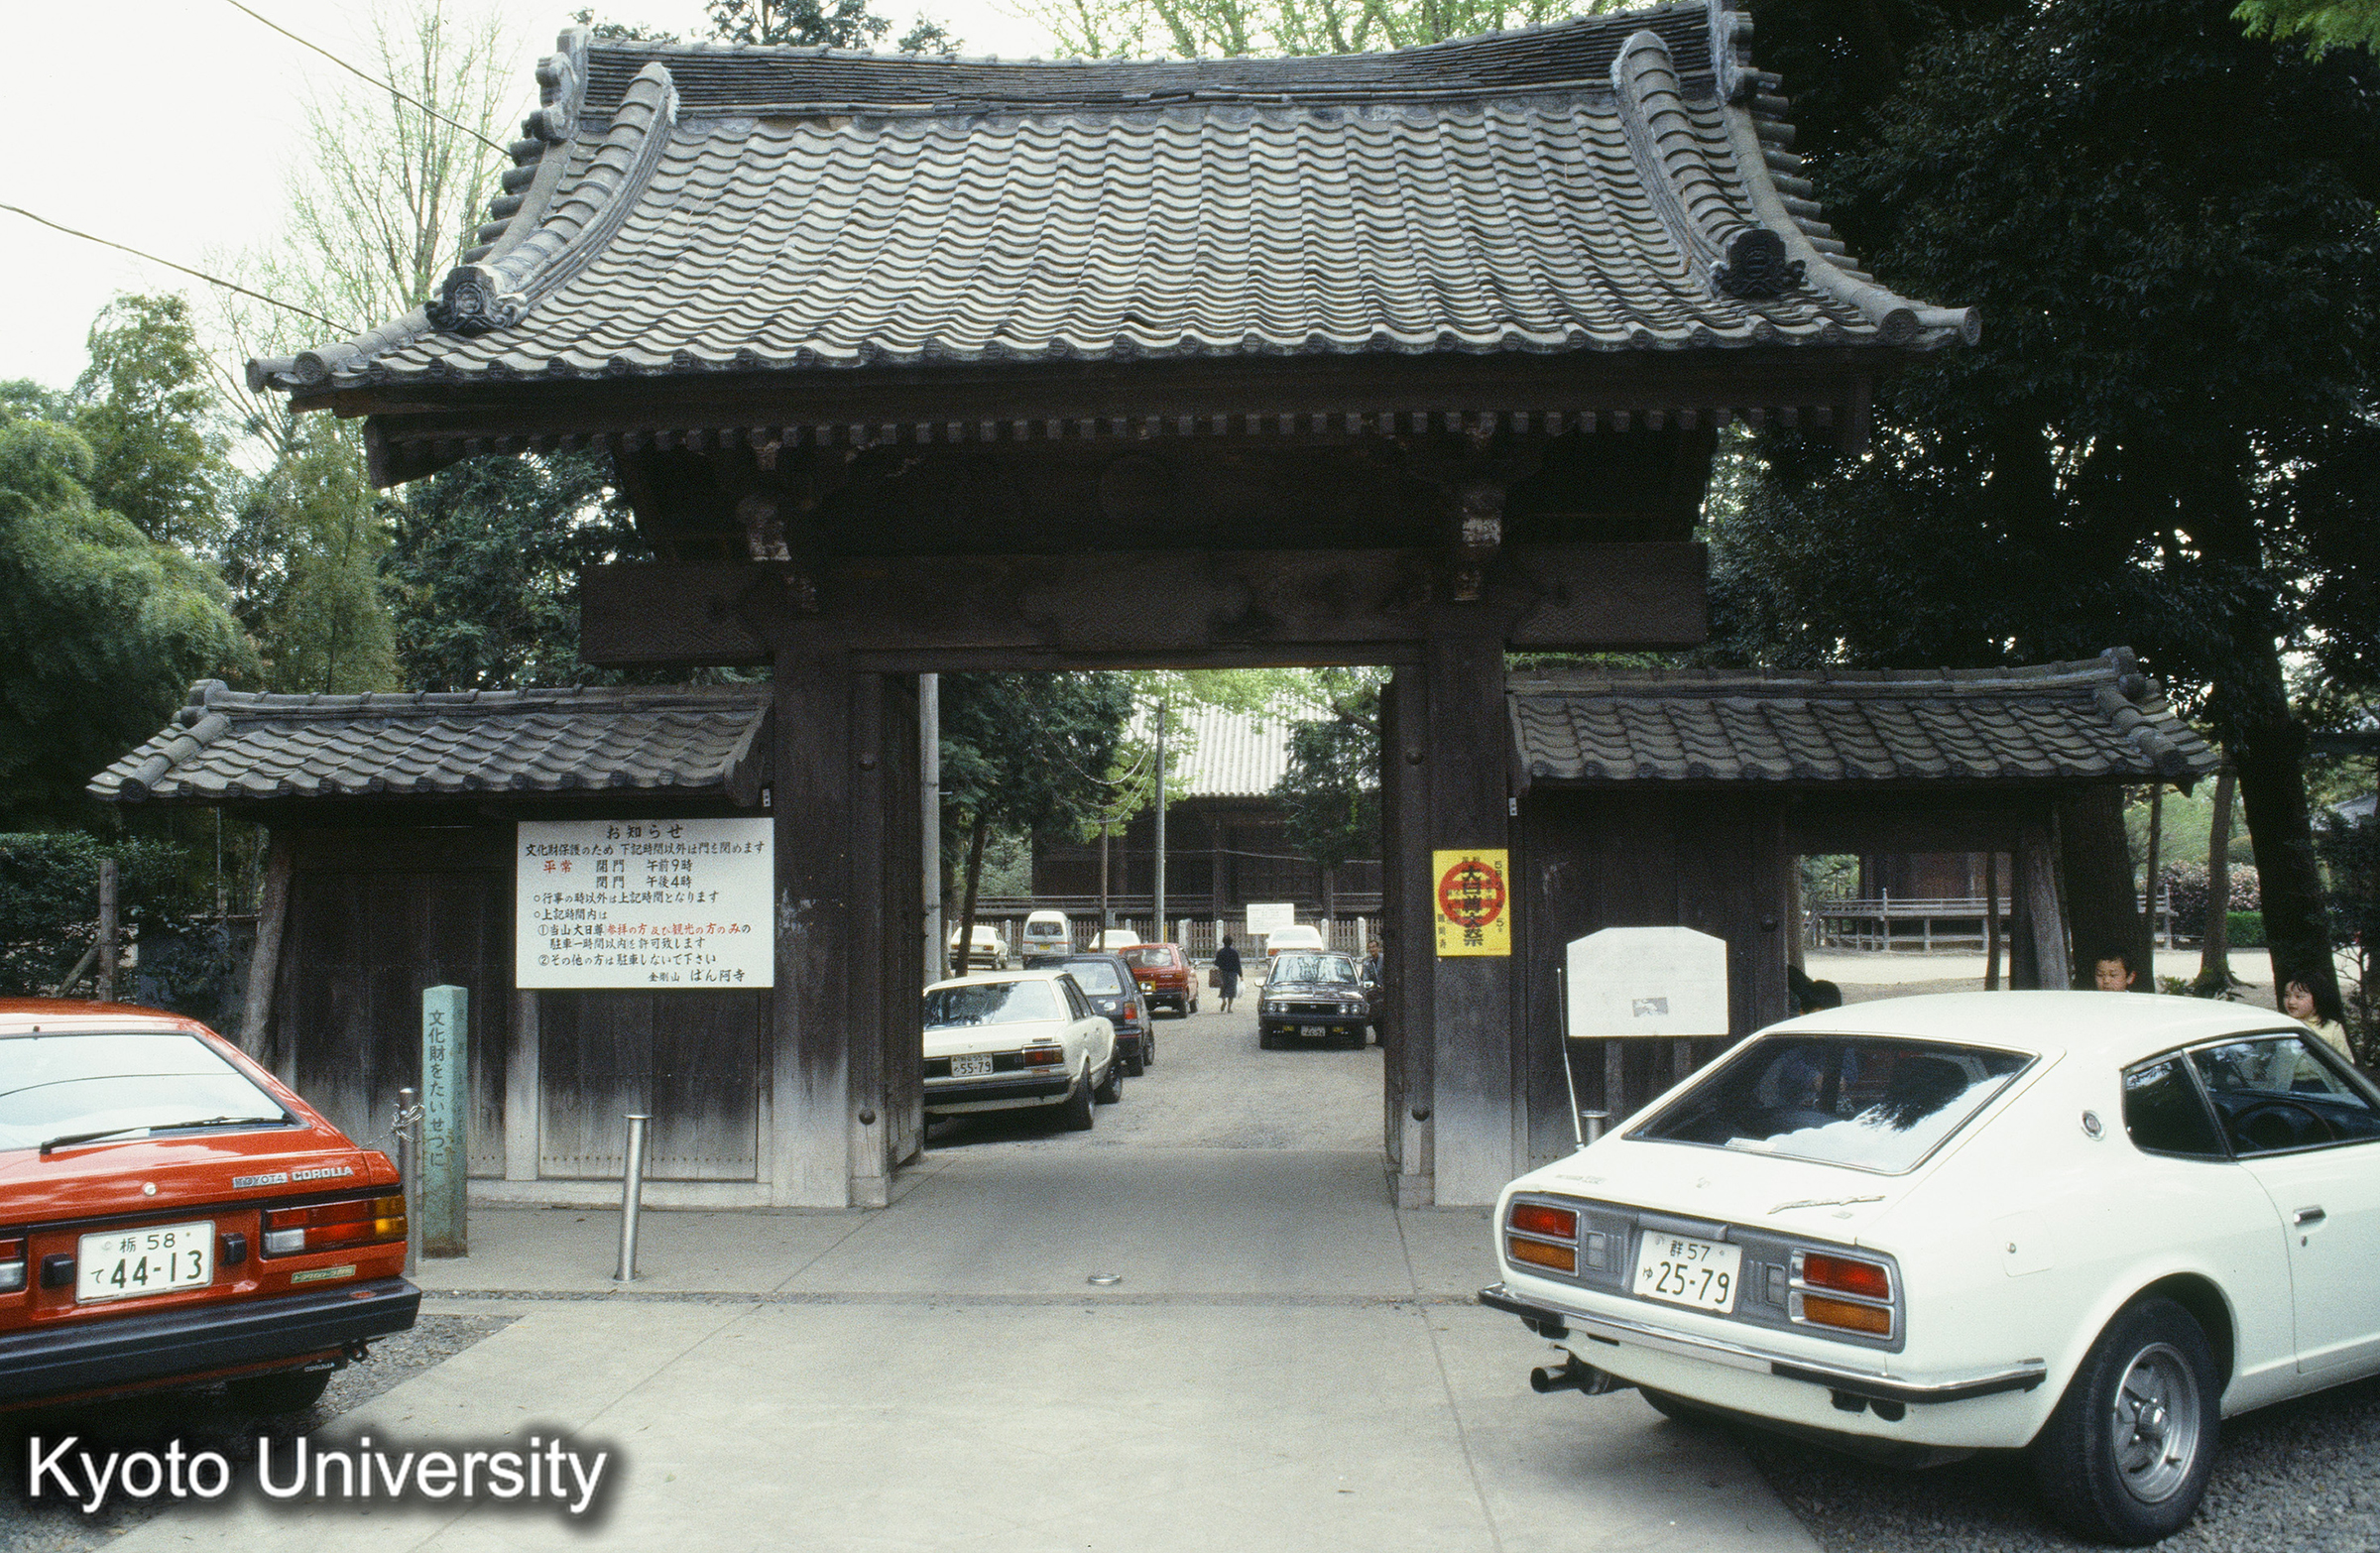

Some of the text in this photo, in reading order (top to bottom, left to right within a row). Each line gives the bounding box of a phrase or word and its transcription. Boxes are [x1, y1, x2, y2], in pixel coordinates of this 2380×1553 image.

[606, 824, 683, 840] お知らせ
[542, 859, 572, 874] 平常
[647, 859, 693, 873] 午前9時
[646, 875, 693, 889] 午後4時
[428, 1010, 446, 1168] 文化財をたいせつに
[233, 1166, 354, 1188] TOYOTA COROLLA
[120, 1233, 177, 1254] 栃 58
[1670, 1240, 1711, 1262] 群 57
[90, 1250, 203, 1289] て 44-13
[1642, 1260, 1730, 1305] ゆ 25-79
